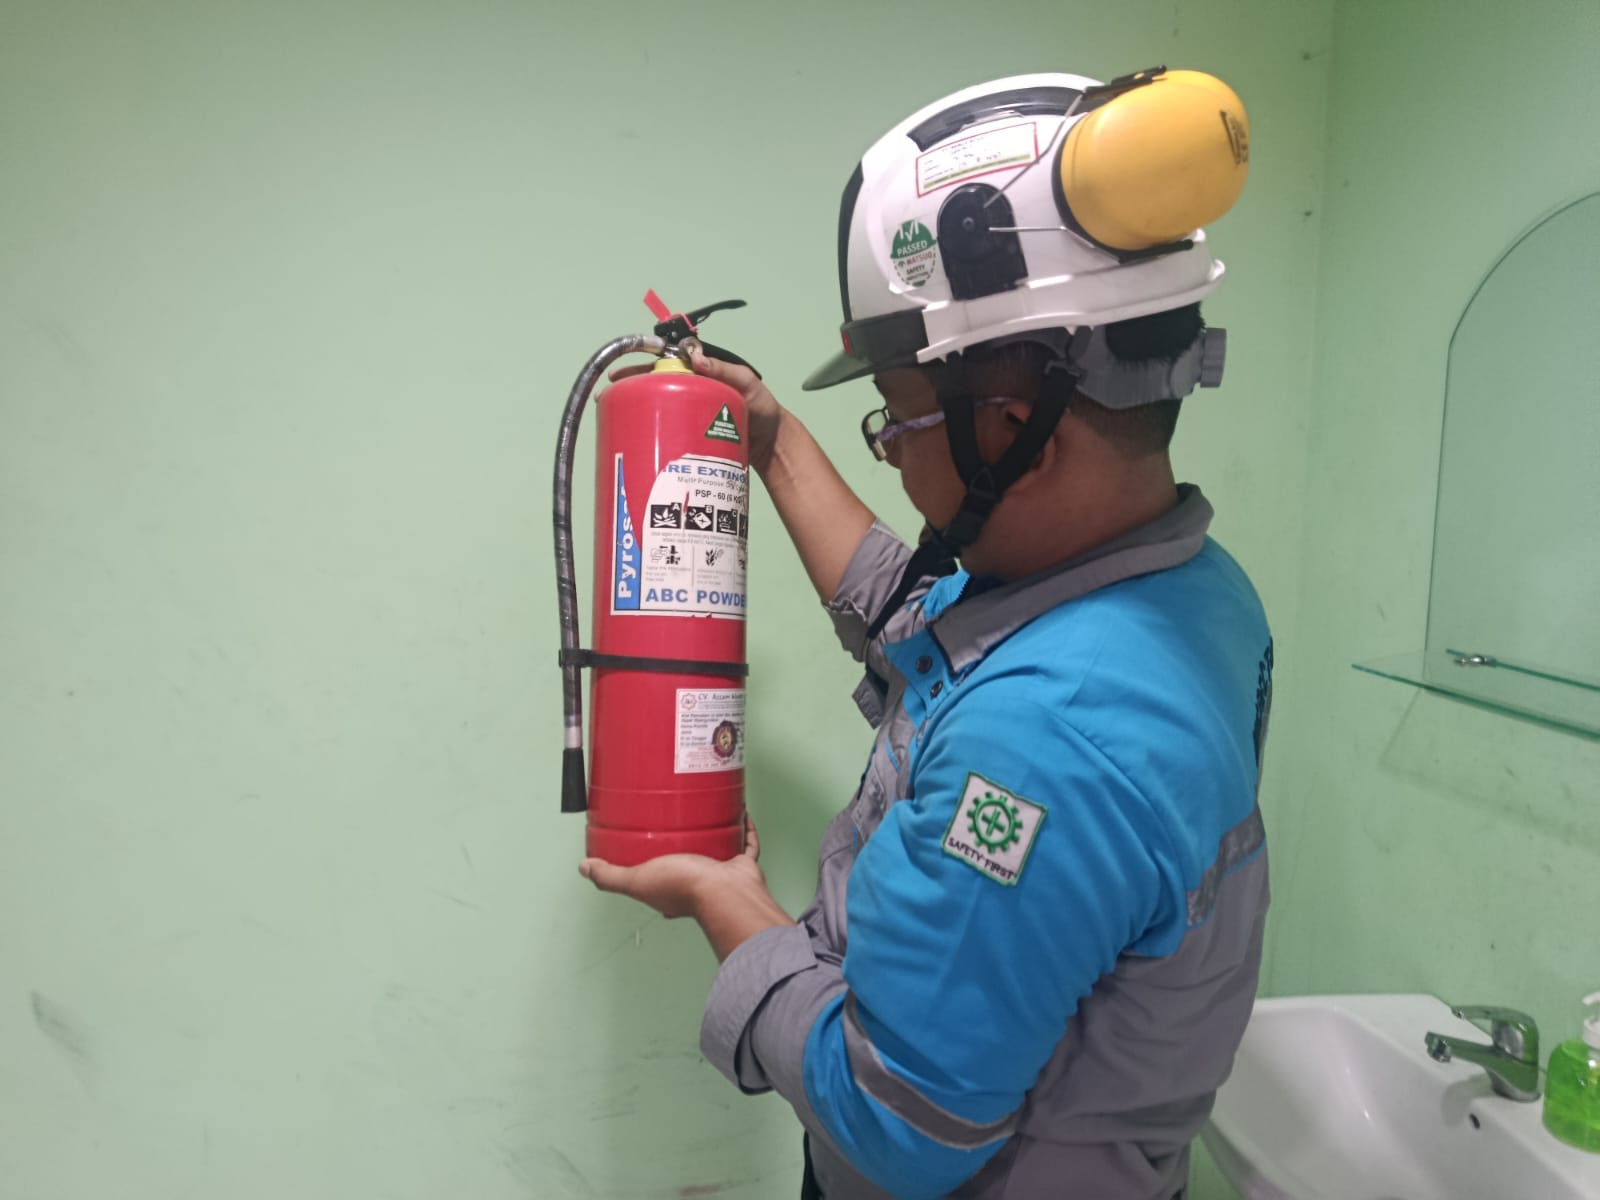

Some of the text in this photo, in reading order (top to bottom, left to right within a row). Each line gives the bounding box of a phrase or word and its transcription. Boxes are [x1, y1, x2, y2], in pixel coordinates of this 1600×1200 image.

[896, 240, 928, 257] PASSED
[695, 489, 712, 498] PSP
[645, 588, 688, 603] ABC
[947, 837, 1018, 880] SAFETY FIRST
